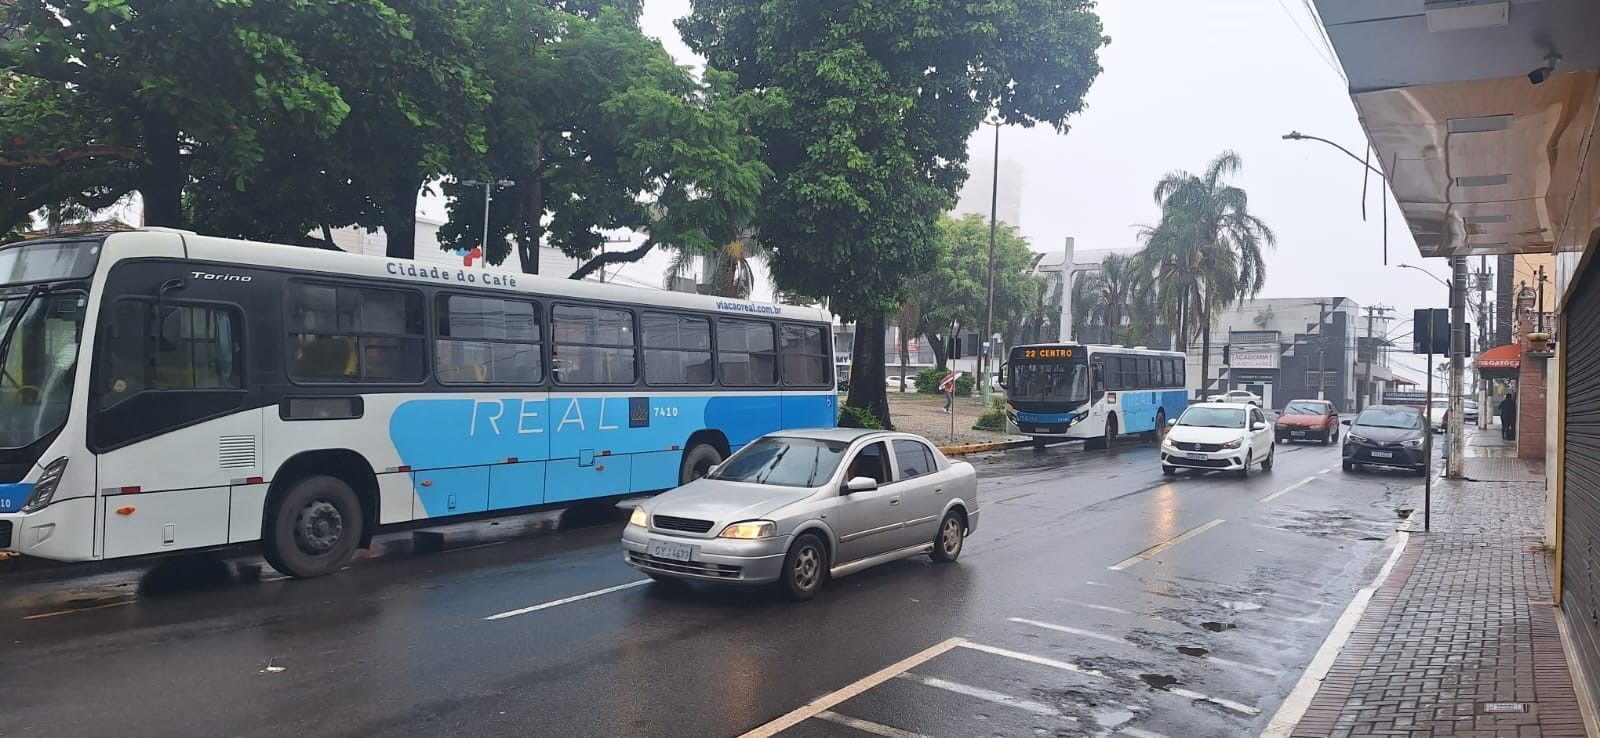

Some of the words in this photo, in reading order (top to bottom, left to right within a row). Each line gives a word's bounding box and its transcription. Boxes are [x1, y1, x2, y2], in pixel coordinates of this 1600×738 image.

[191, 271, 252, 282] Torino
[386, 262, 450, 281] Cidade
[457, 270, 476, 283] do
[716, 301, 782, 315] viacaoreal.com.br
[1025, 350, 1036, 358] 22
[1039, 349, 1073, 358] CENTRO
[469, 397, 620, 437] REAL
[653, 407, 679, 417] 7410
